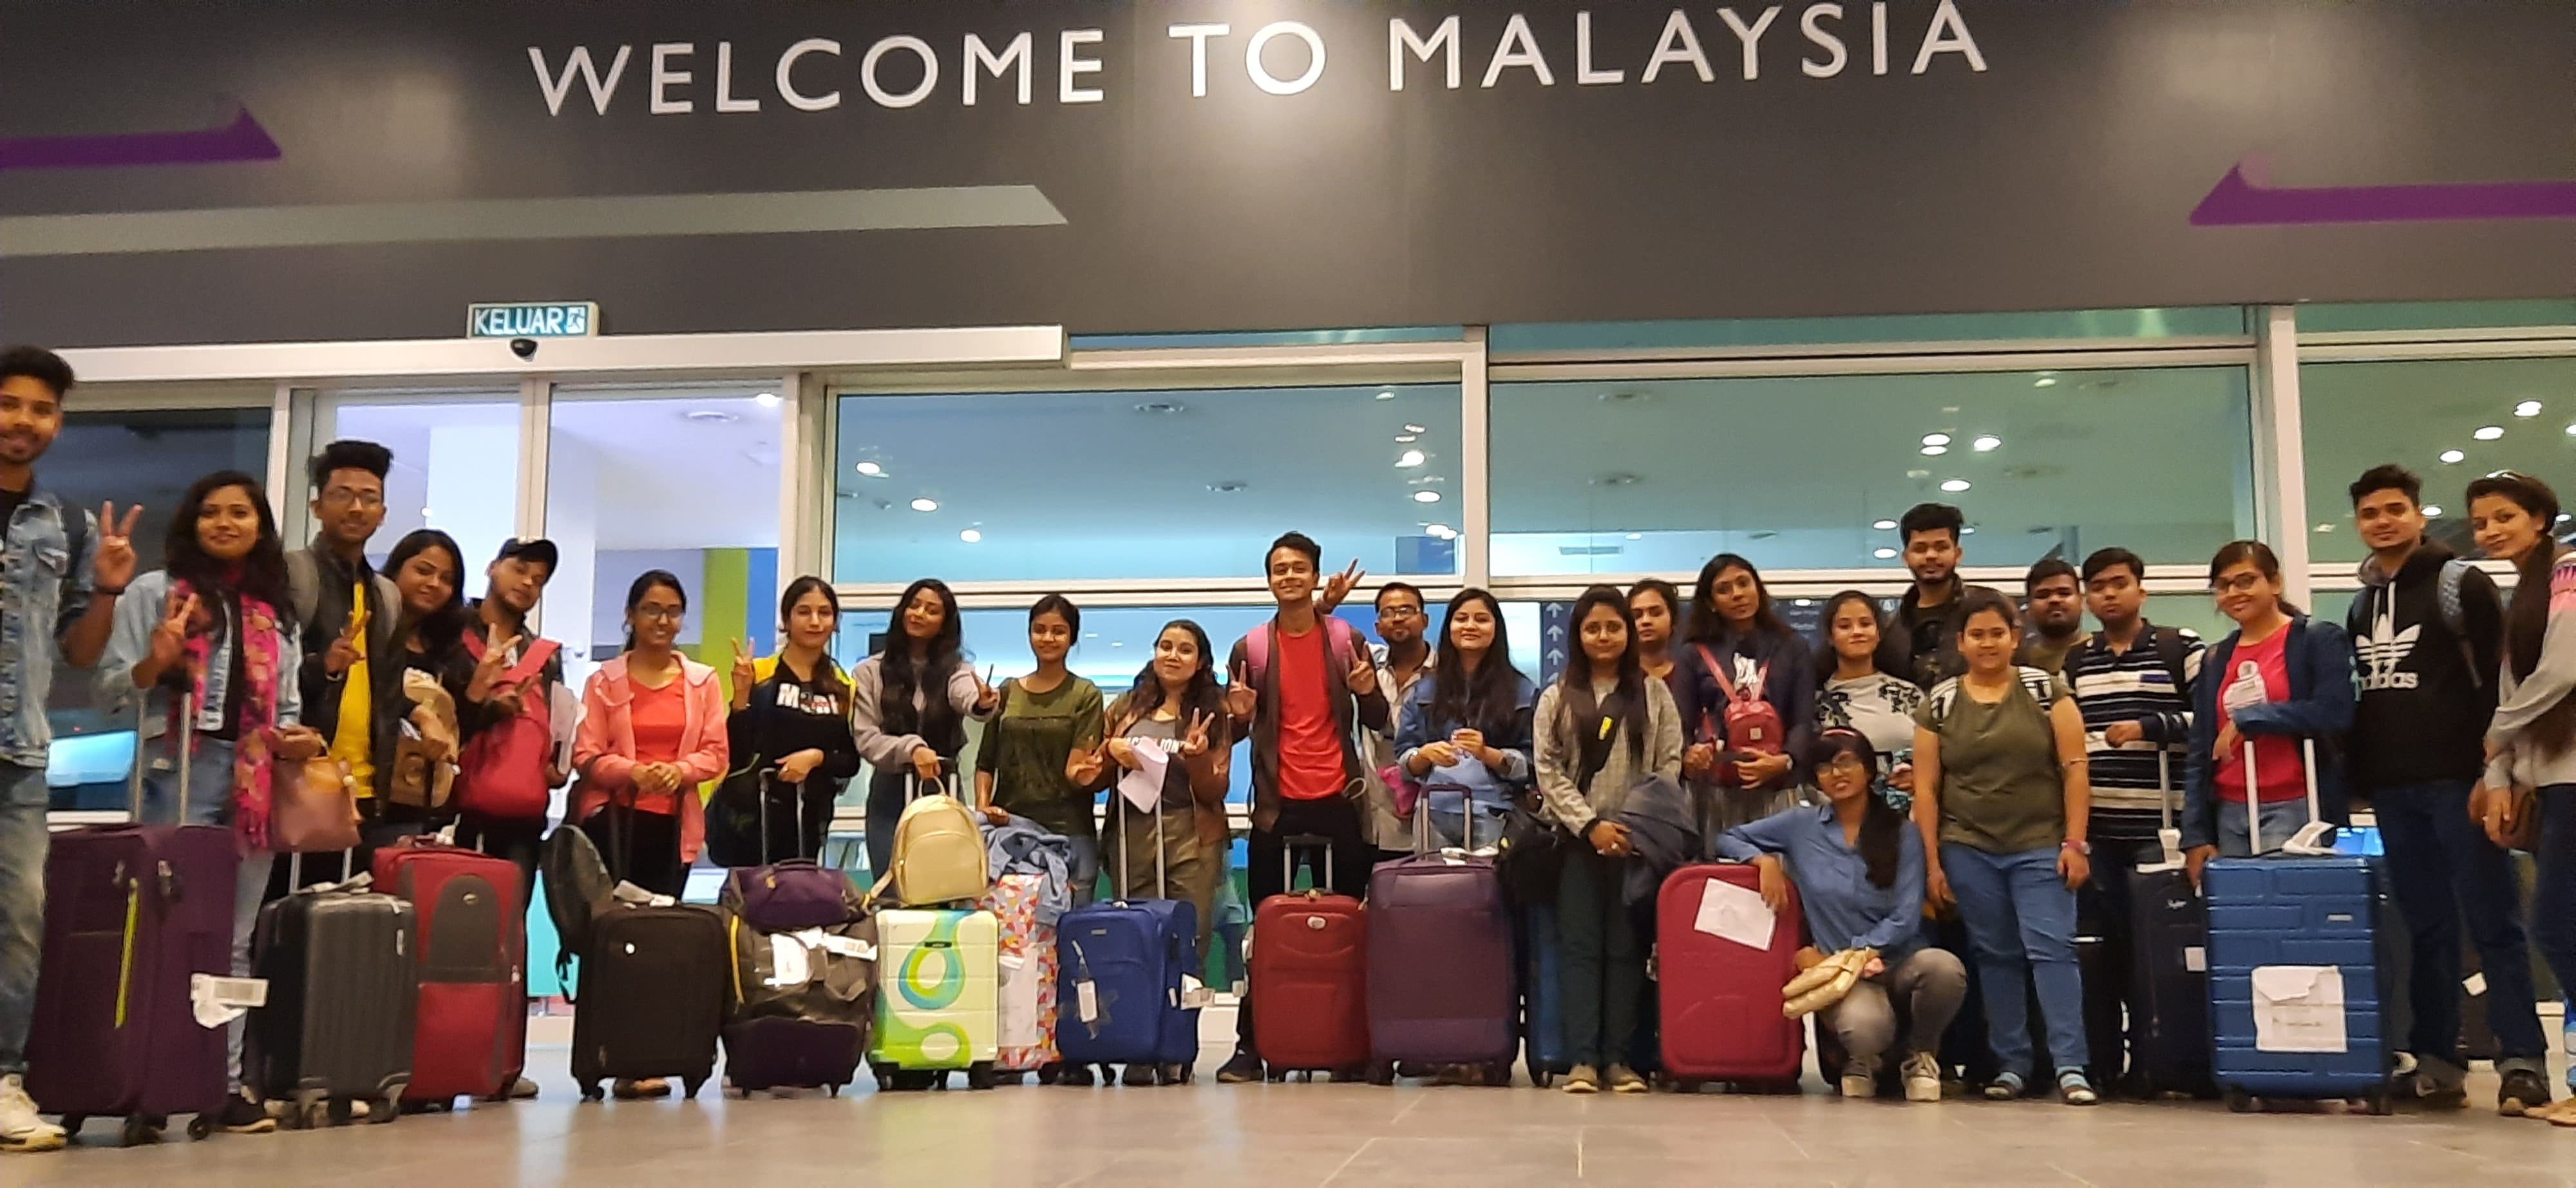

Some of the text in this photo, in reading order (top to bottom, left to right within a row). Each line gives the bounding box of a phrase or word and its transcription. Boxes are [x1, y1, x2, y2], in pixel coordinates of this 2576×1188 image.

[527, 0, 1987, 117] WELCOME TO MALAYSIA
[474, 307, 563, 335] KELUAR
